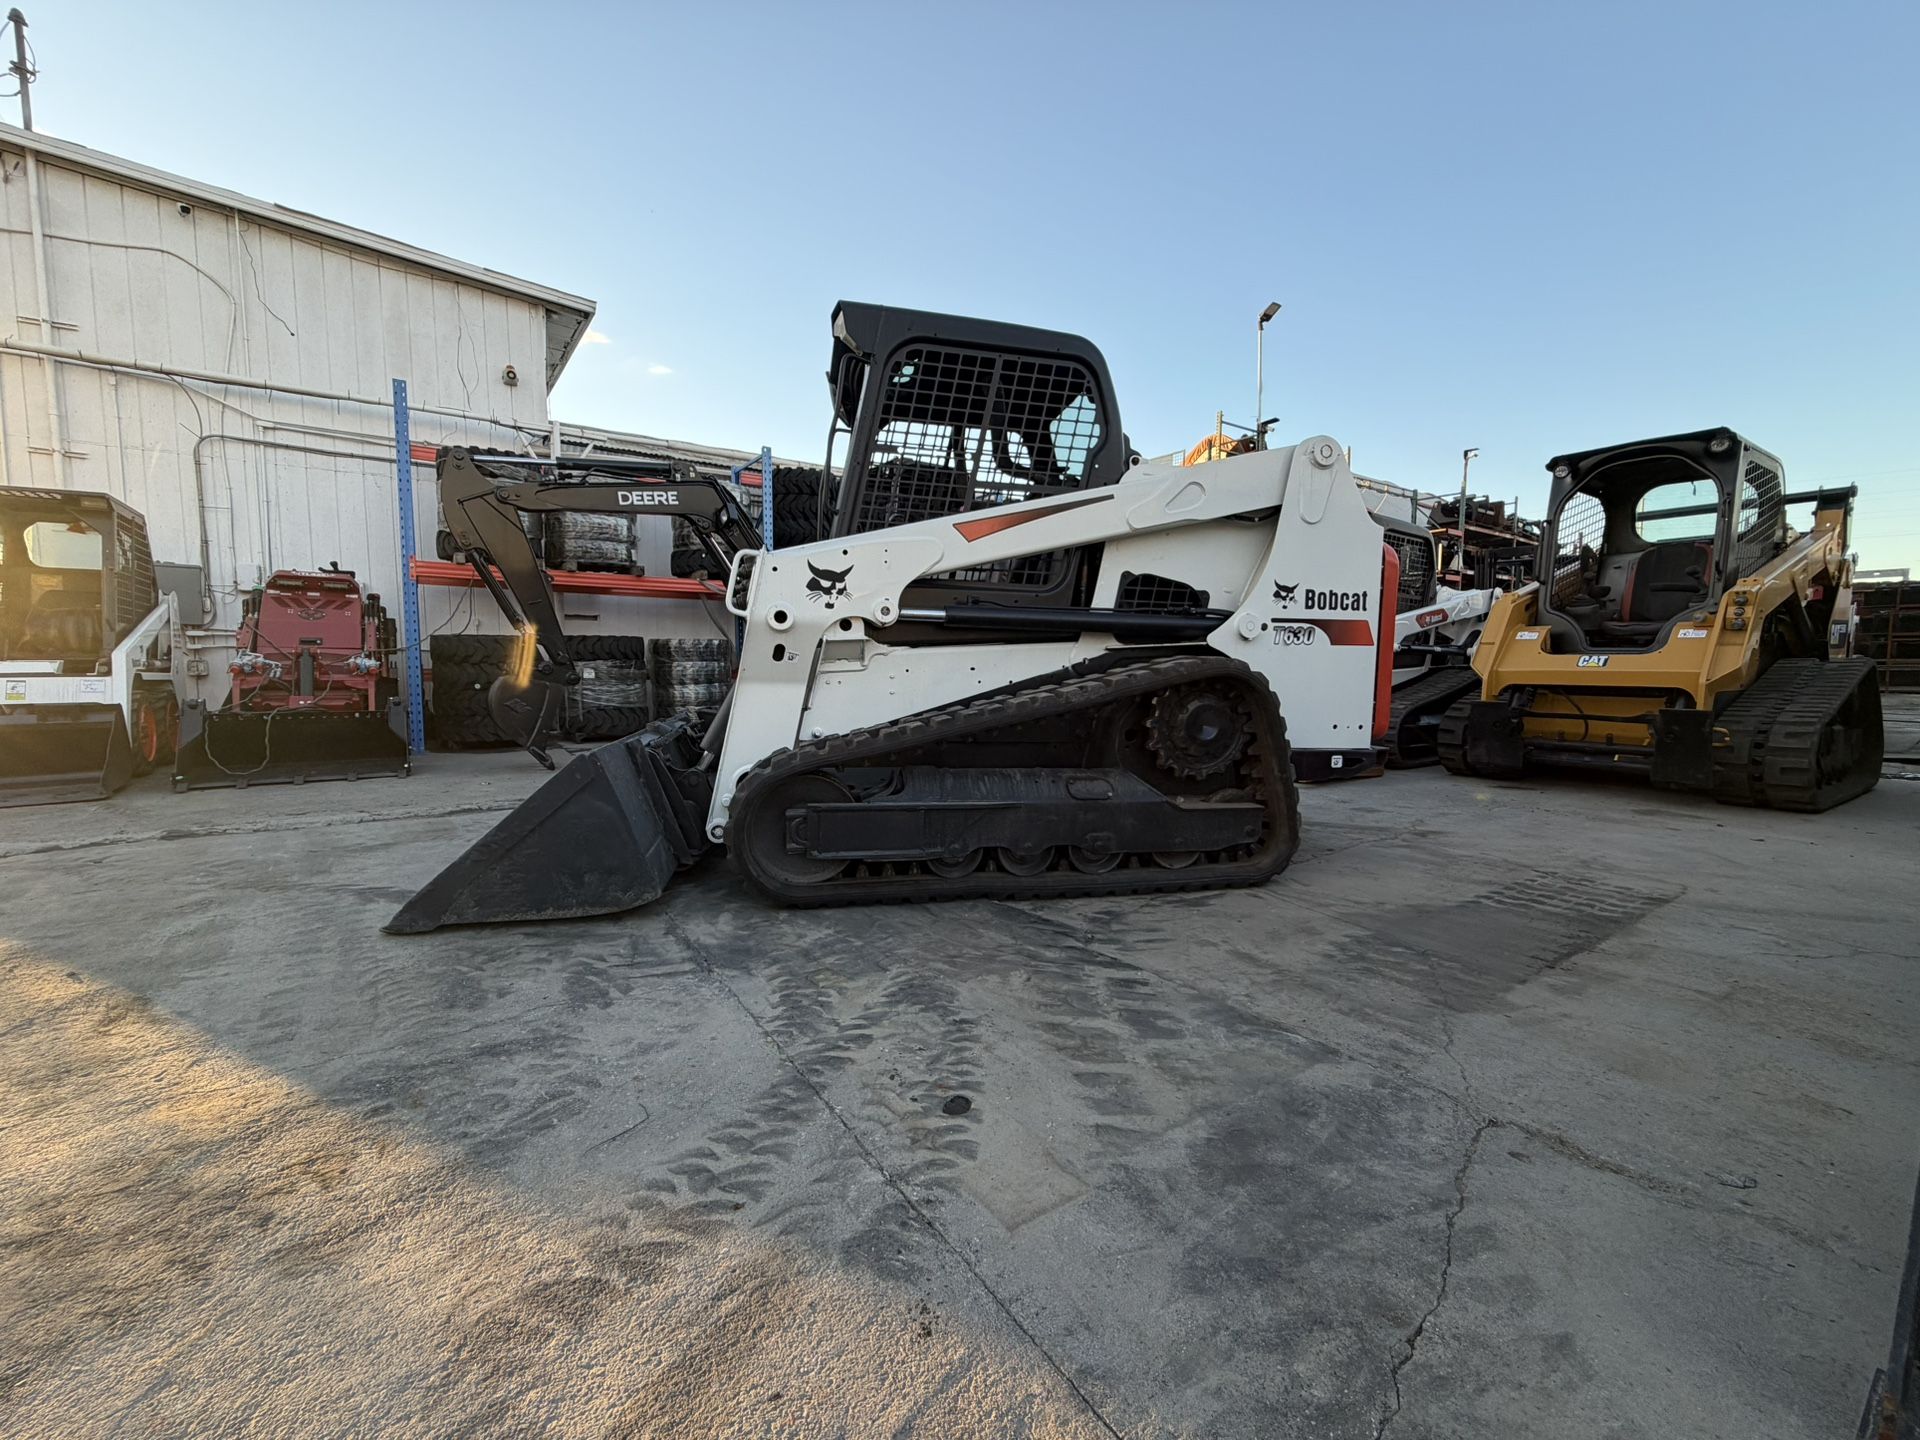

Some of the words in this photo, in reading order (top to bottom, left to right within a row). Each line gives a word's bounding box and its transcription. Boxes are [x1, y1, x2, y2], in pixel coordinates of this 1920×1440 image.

[617, 491, 679, 505] DEERE
[1304, 588, 1368, 612] Bobcat
[1273, 625, 1316, 646] T630
[1577, 655, 1609, 667] CAT
